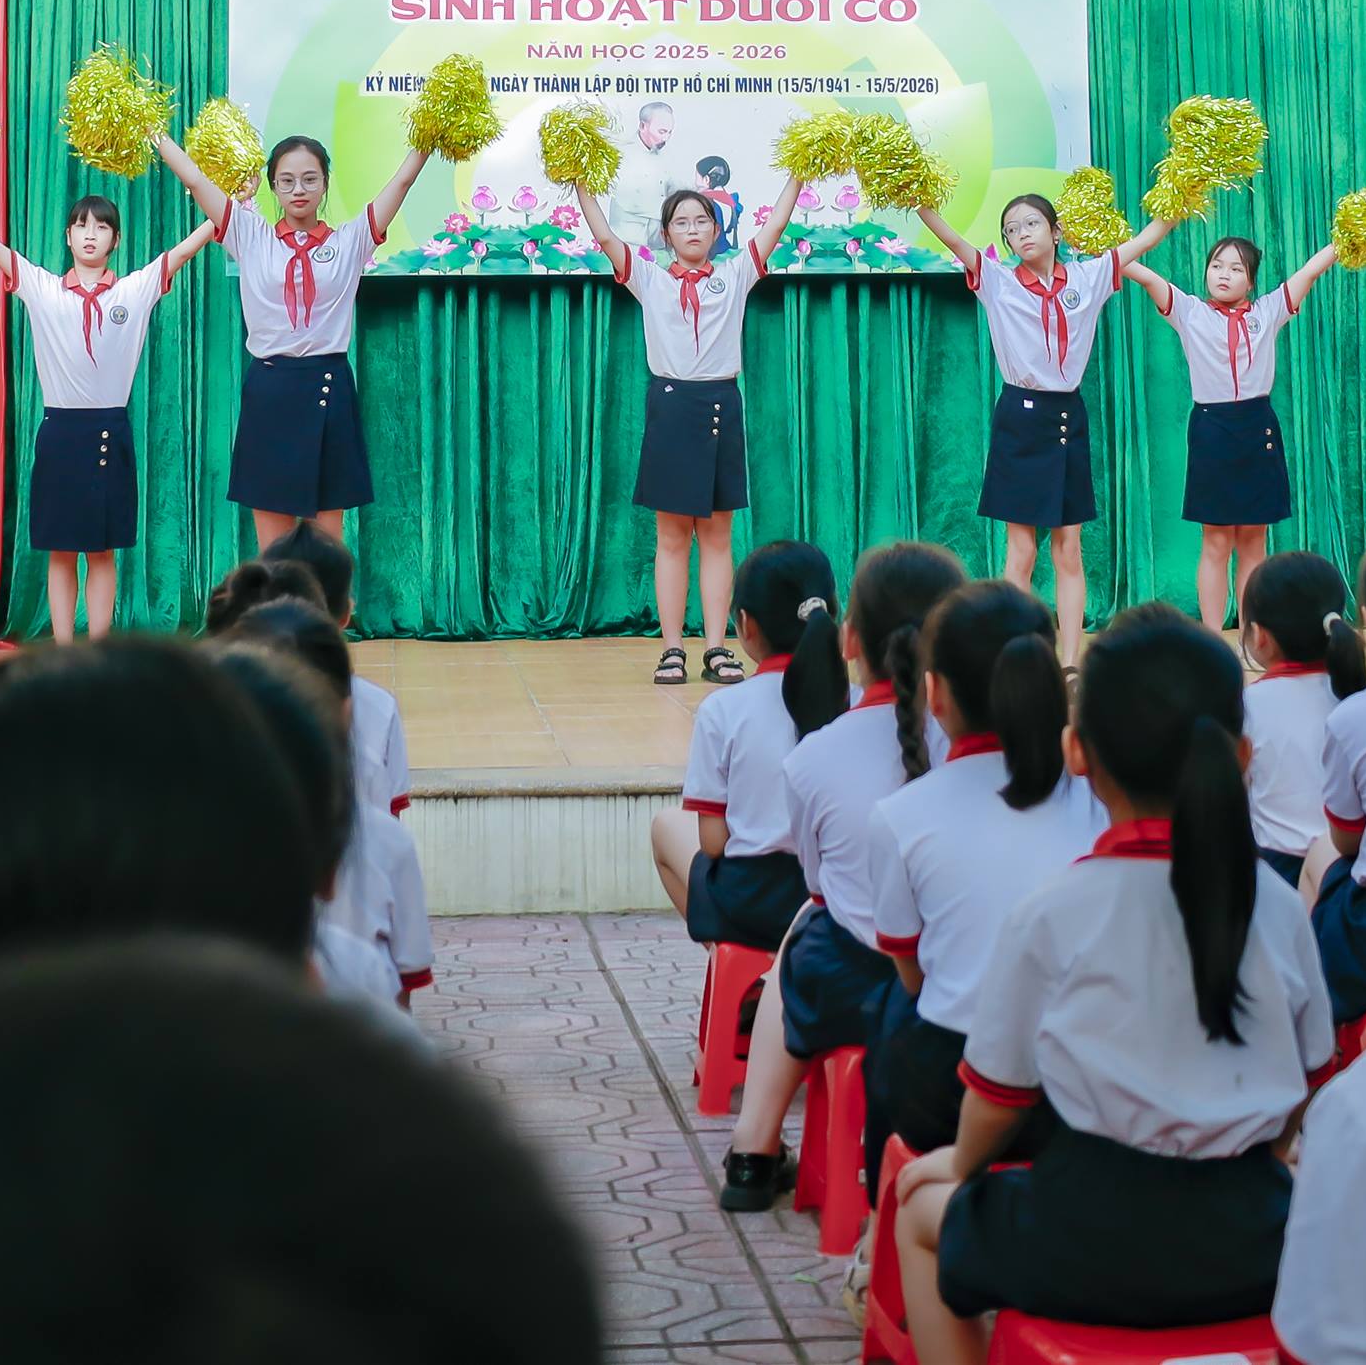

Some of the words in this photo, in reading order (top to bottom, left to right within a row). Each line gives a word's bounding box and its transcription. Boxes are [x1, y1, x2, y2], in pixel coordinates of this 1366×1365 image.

[527, 40, 583, 60] NĂM
[592, 44, 646, 63] HỌC
[655, 44, 710, 60] 2025
[733, 44, 788, 60] 2026
[366, 70, 384, 92] KỶ
[491, 73, 529, 93] NGÀY
[534, 73, 580, 93] THÀNH
[585, 74, 611, 97] LẬP
[616, 74, 639, 97] ĐỘI
[645, 77, 679, 93] TNTP
[707, 73, 730, 93] CHÍ
[735, 77, 772, 93] MINH
[777, 77, 851, 95] (15/5/1941
[866, 77, 939, 95] 15/5/2026)
